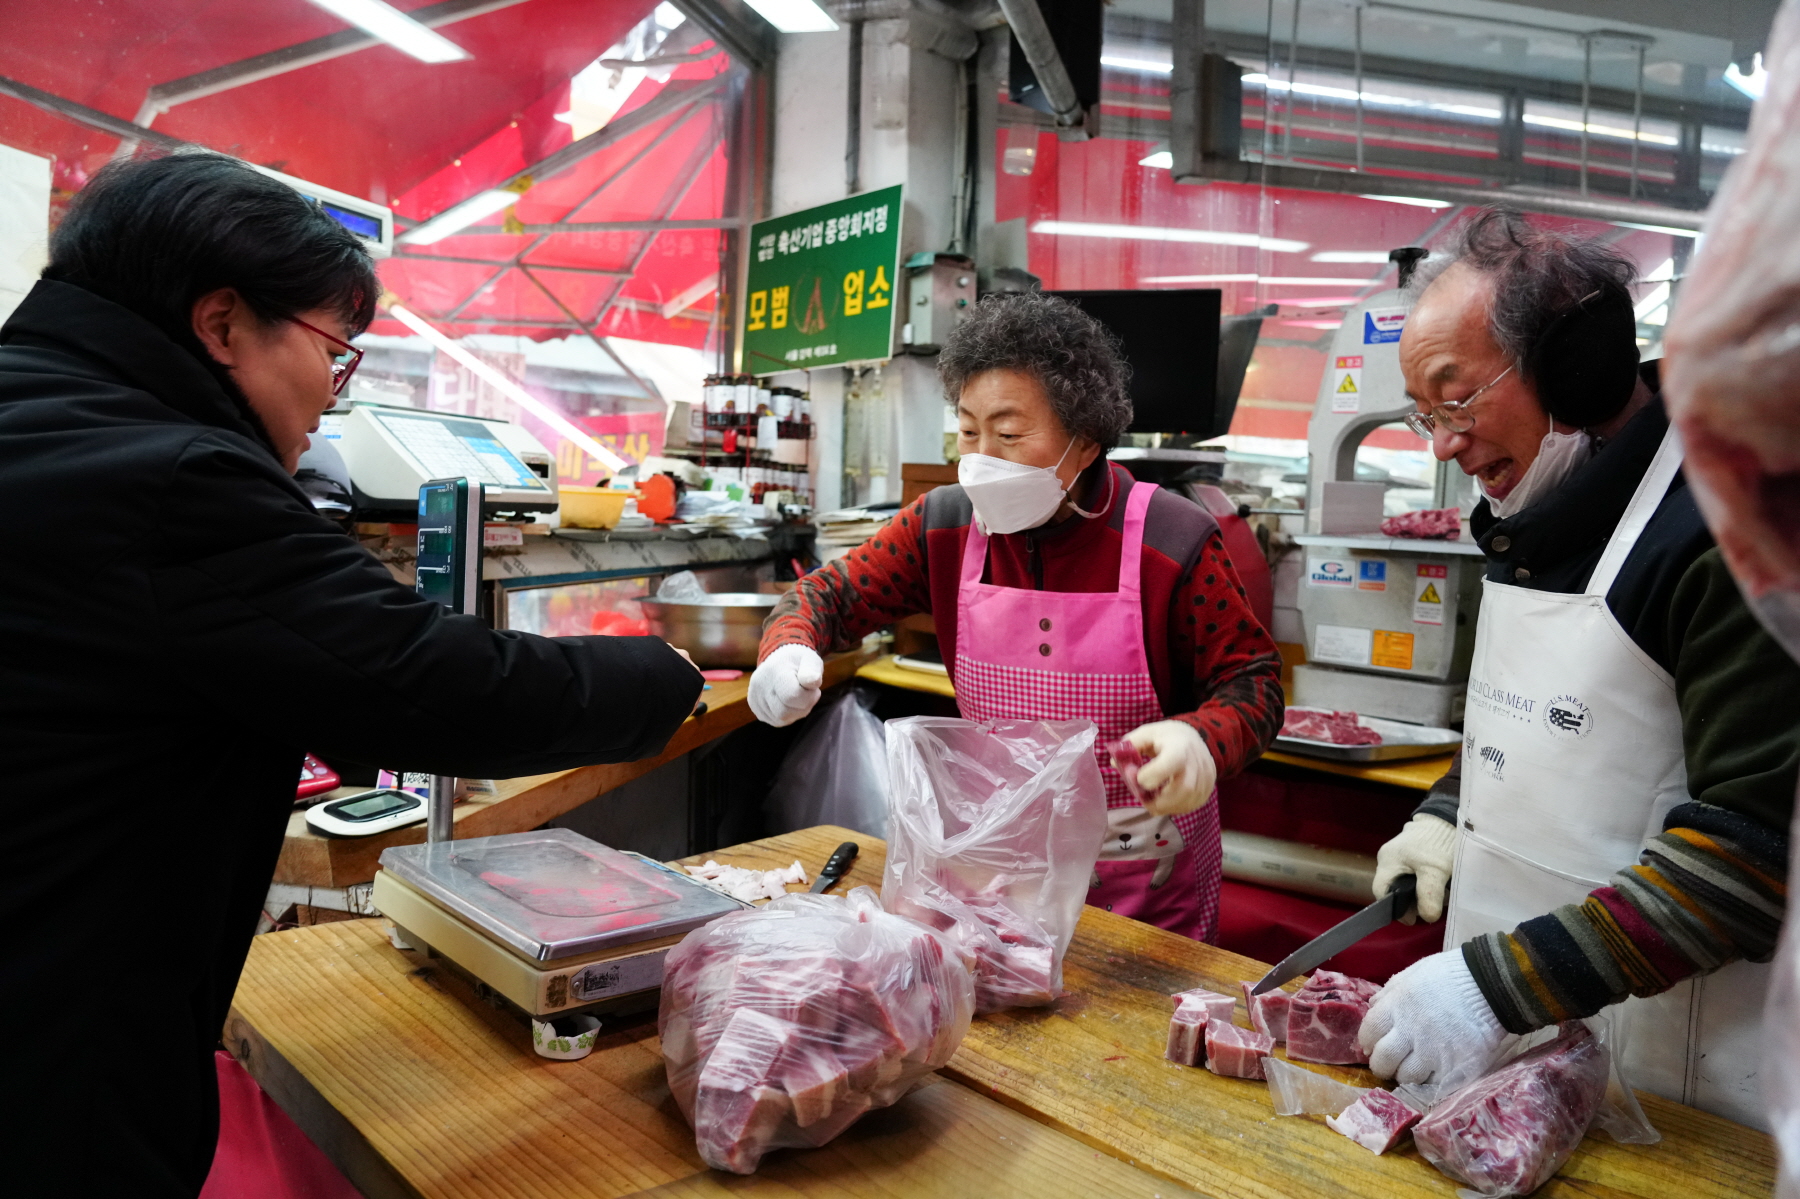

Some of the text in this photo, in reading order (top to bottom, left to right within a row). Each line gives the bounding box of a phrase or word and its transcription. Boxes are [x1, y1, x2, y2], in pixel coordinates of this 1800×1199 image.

[778, 221, 824, 255] 축산기업
[748, 265, 890, 331] 모범 업소
[1312, 573, 1352, 583] Global
[1469, 677, 1537, 713] ORLD CLASS MEAT
[1565, 694, 1589, 712] MEAT
